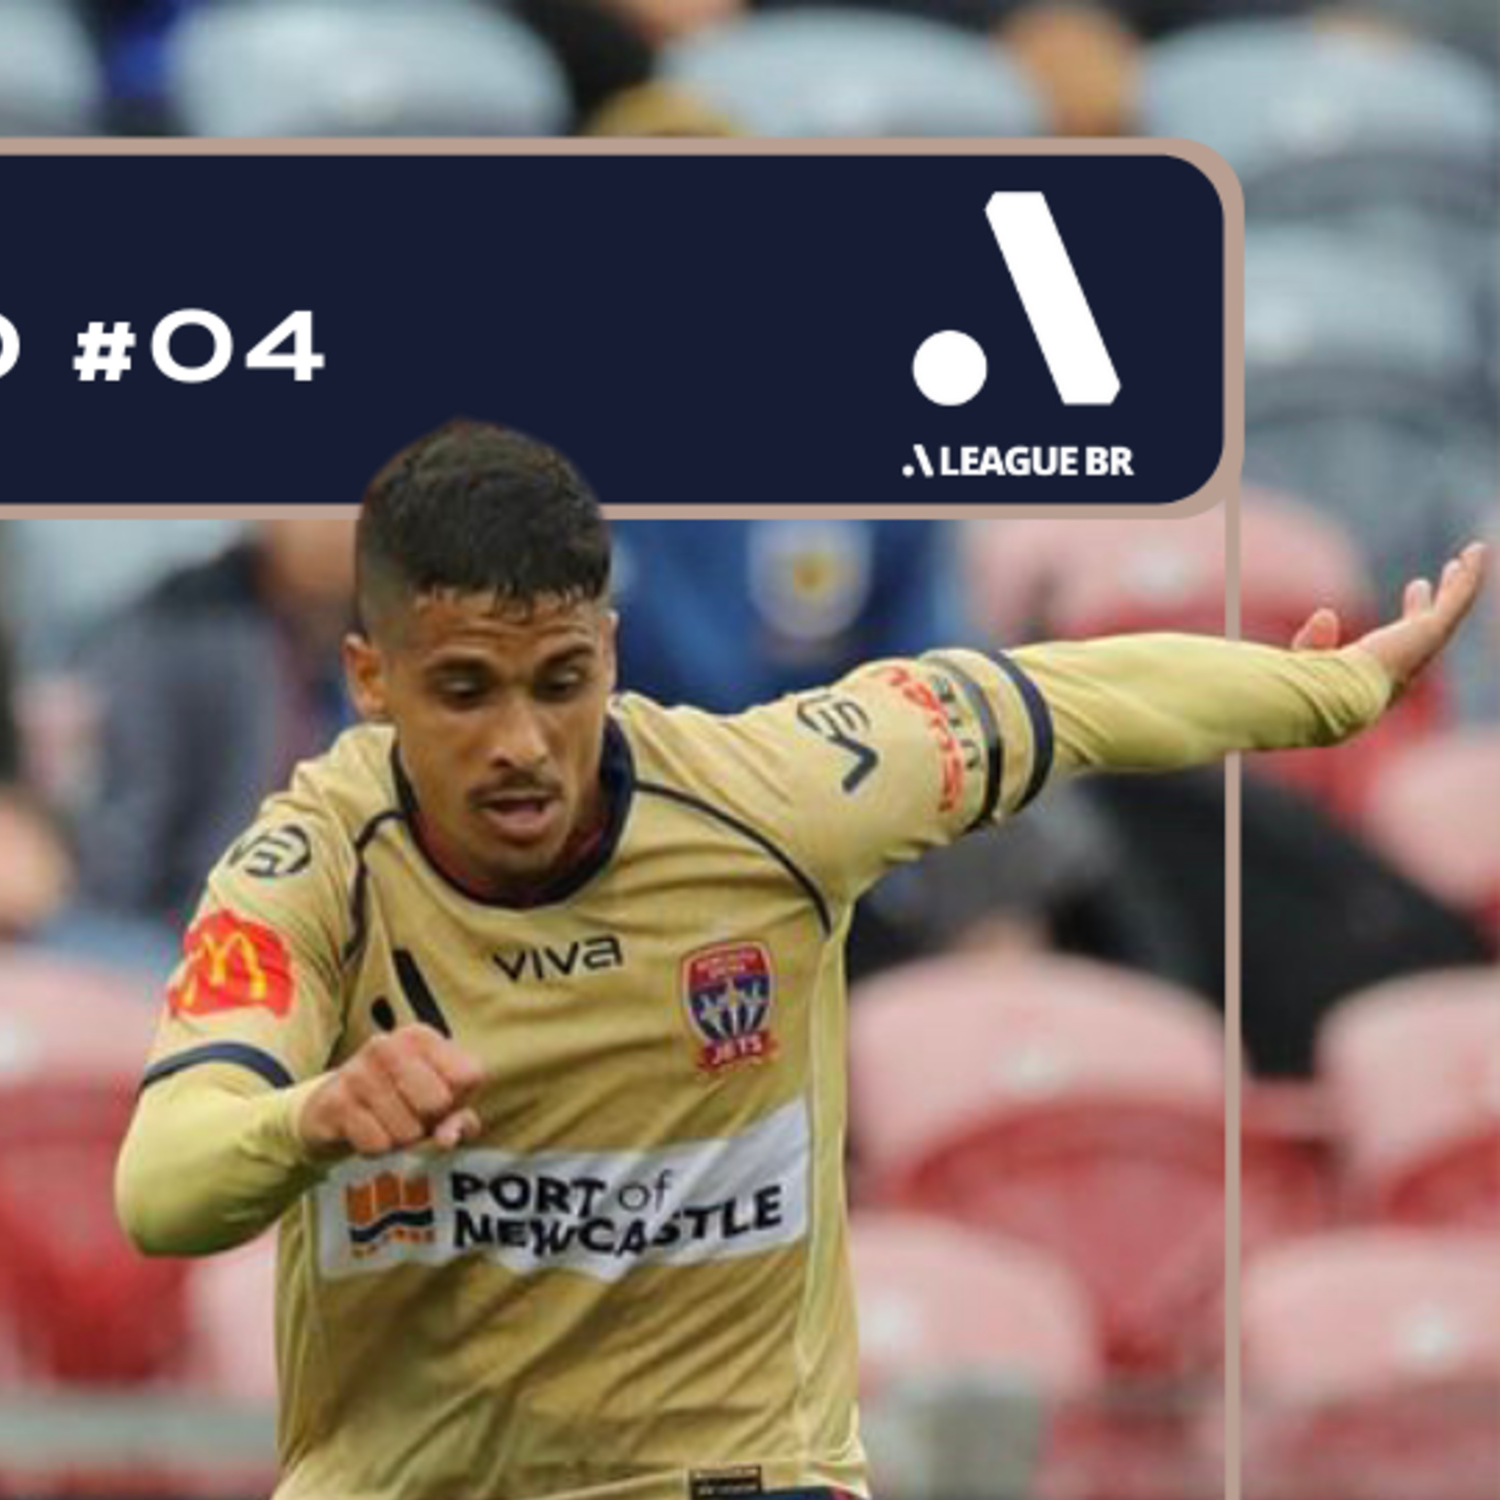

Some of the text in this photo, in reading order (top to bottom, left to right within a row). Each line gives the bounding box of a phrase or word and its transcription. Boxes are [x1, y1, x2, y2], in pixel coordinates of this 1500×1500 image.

[449, 1168, 674, 1216] PORT of
[452, 1185, 784, 1258] NEWCASTLE
